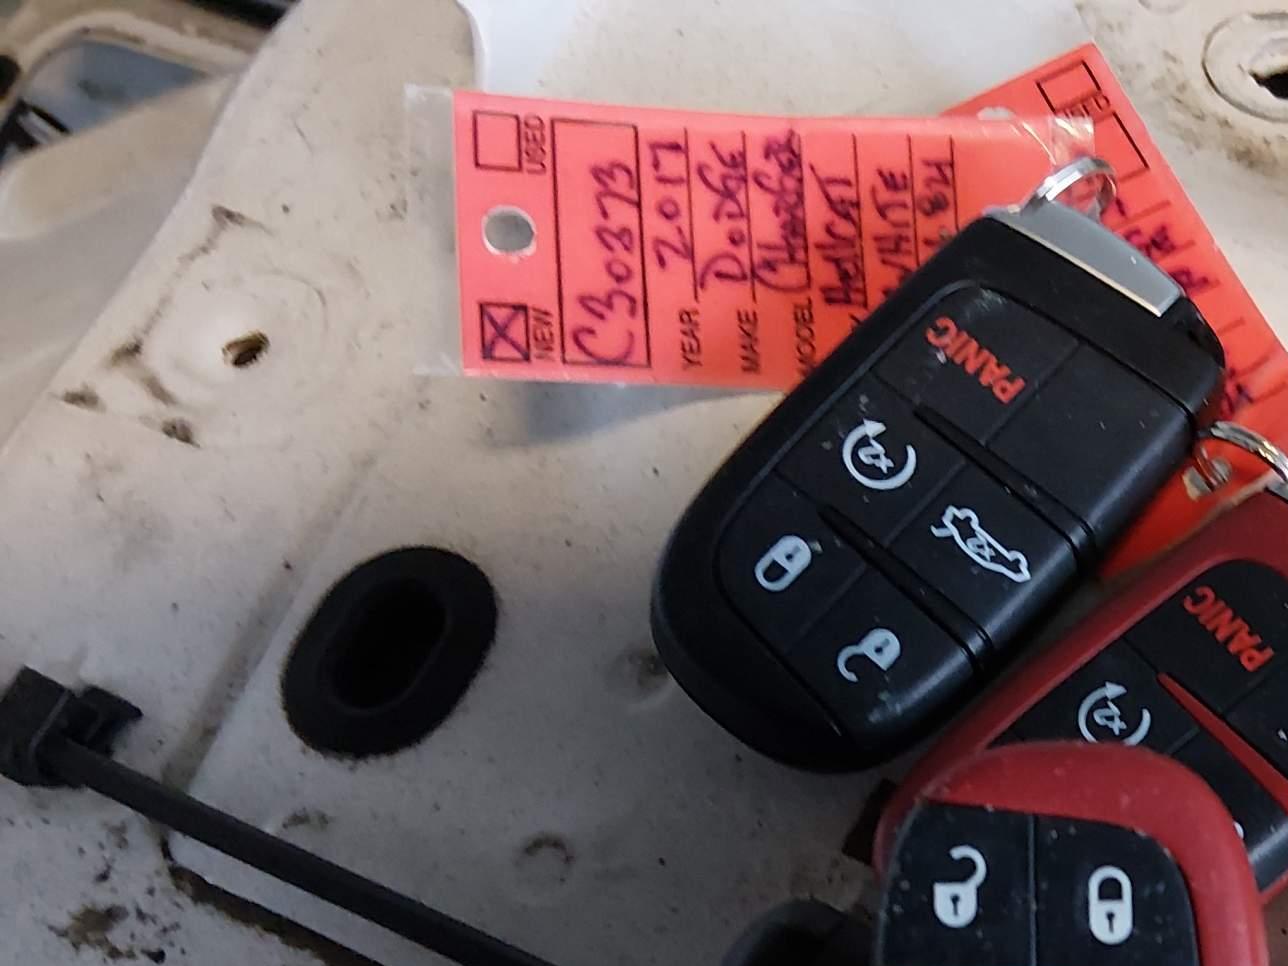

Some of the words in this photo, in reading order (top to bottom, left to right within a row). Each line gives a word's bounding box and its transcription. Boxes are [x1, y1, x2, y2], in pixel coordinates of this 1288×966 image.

[524, 115, 546, 174] USED
[649, 141, 693, 269] 2017
[532, 306, 556, 362] NEW
[679, 308, 702, 370] YEAR
[737, 309, 761, 374] MAKE
[926, 315, 1026, 405] PANIC
[1183, 586, 1275, 672] PANIC
